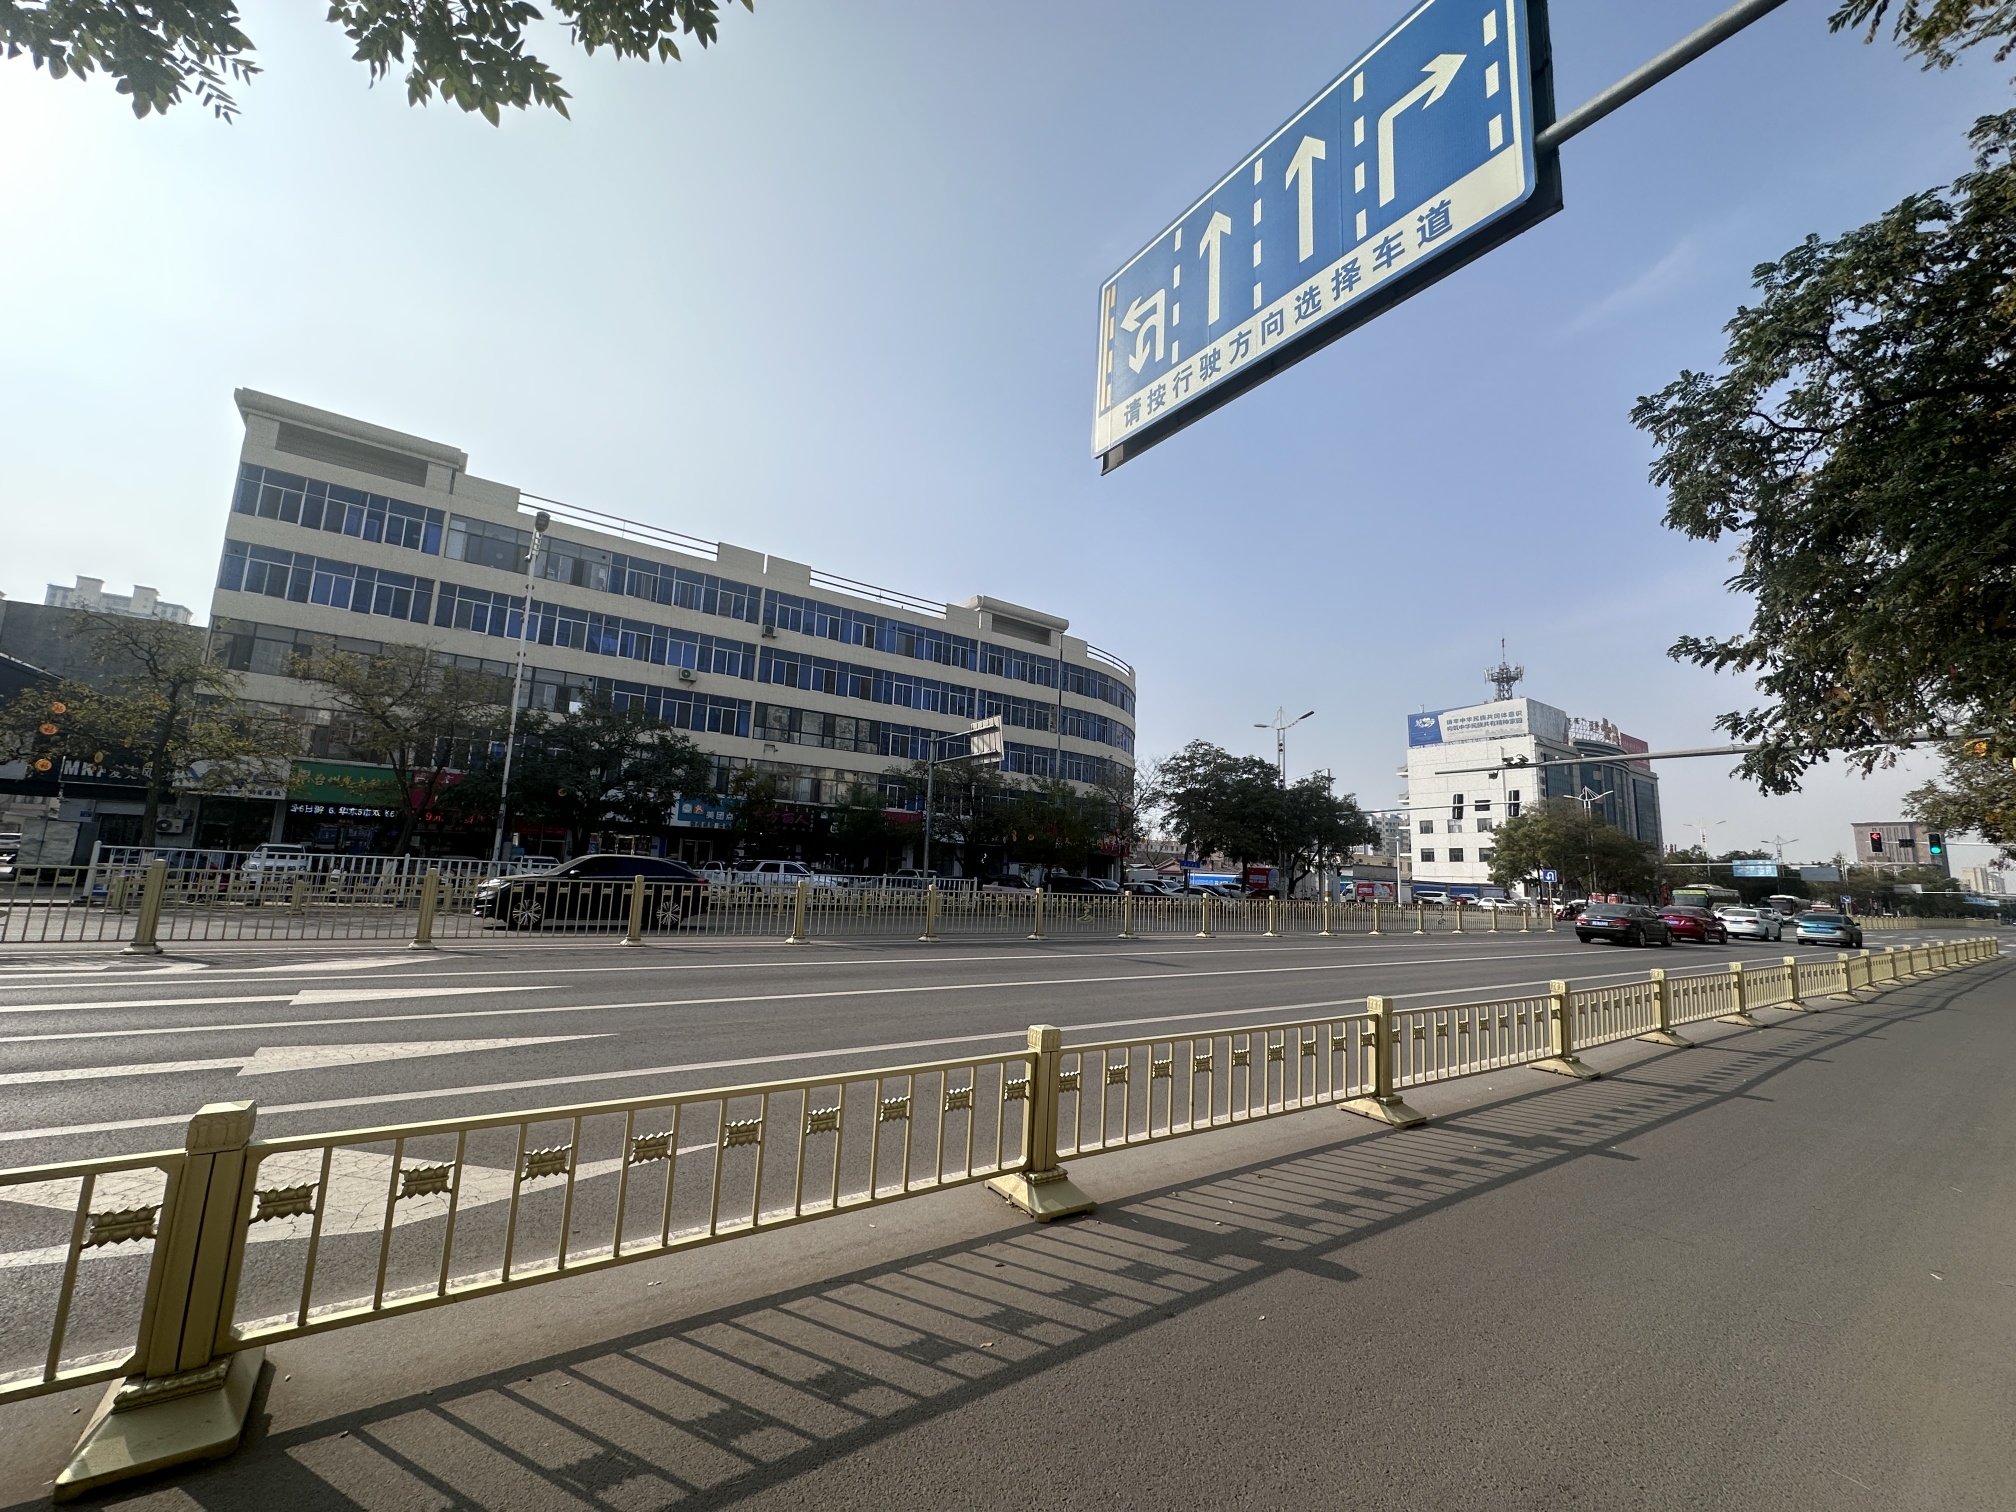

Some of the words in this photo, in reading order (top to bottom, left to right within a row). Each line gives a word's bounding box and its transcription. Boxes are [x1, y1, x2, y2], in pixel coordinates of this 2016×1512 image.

[1123, 199, 1453, 428] 请按行驶方向选择车道
